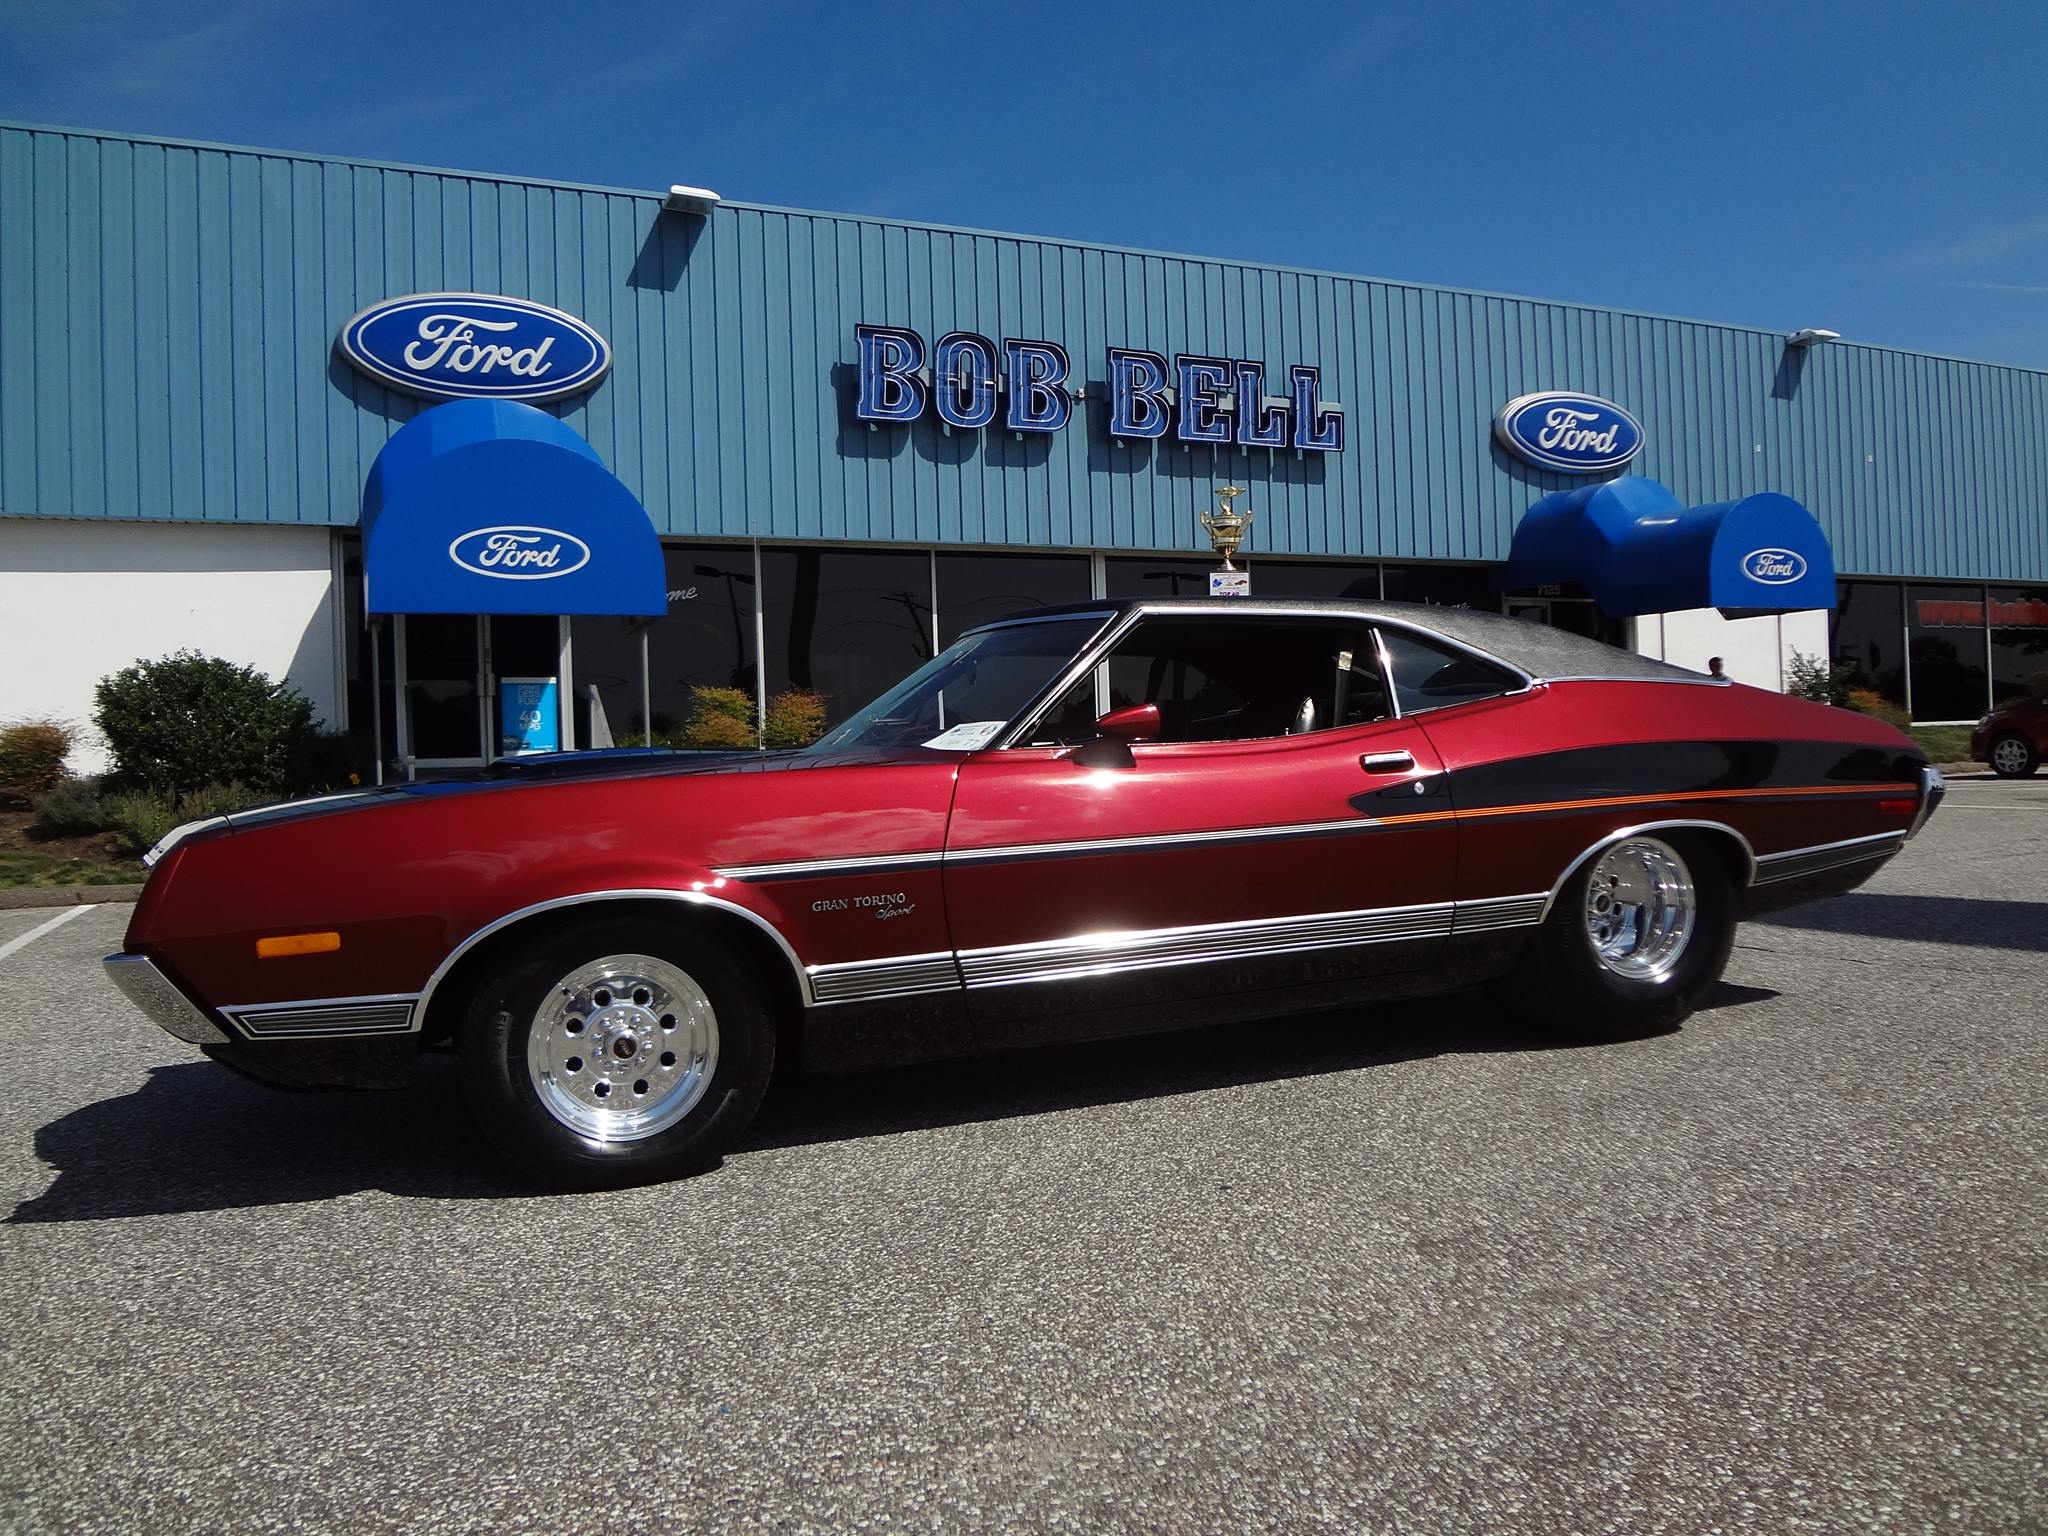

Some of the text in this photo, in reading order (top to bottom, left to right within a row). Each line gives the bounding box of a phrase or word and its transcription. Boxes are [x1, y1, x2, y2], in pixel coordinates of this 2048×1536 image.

[404, 314, 556, 377] Ford
[855, 323, 1346, 453] BOB BELL
[1538, 407, 1619, 454] Ford
[480, 533, 562, 568] Ford
[1756, 553, 1794, 577] Ford
[812, 892, 906, 912] GRAN TORINO
[876, 903, 916, 921] Sport
